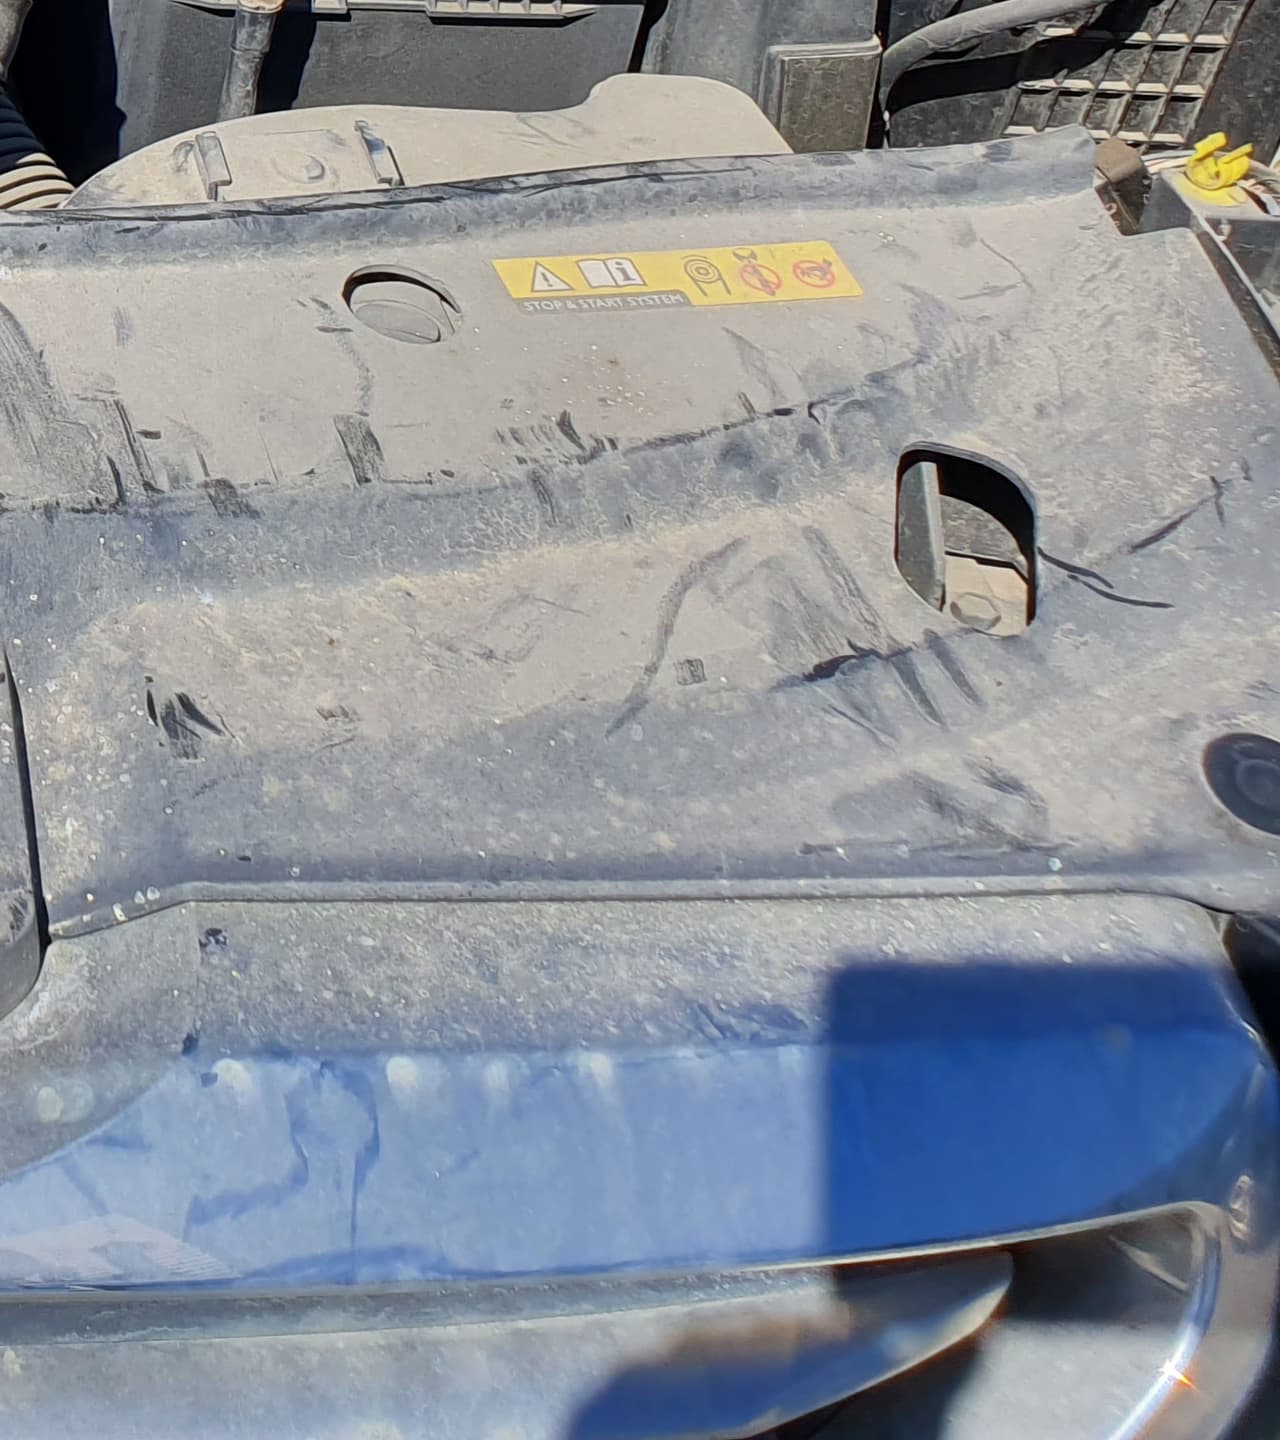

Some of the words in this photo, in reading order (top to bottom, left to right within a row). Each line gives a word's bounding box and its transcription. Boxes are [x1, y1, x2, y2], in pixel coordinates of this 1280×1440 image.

[523, 300, 561, 311] STOP
[567, 299, 578, 310] &
[580, 297, 623, 310] START
[627, 293, 684, 307] SYSTEM
